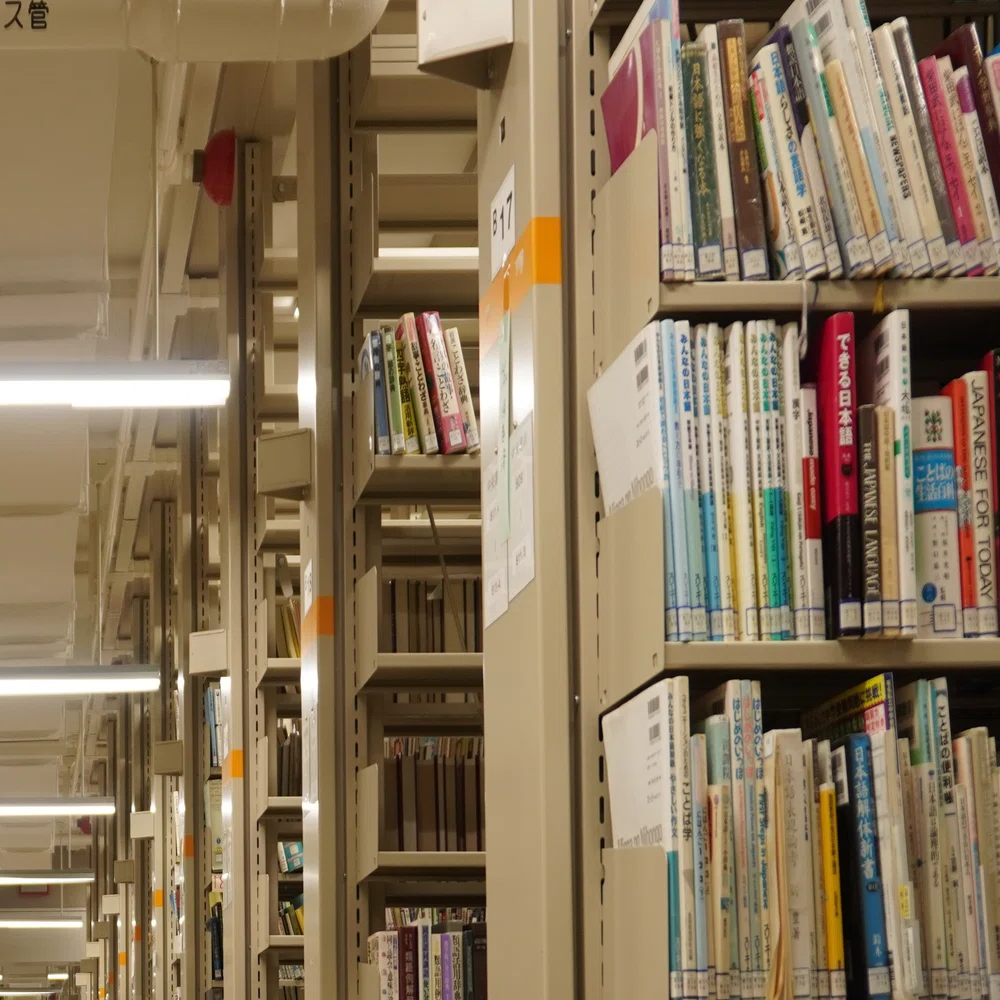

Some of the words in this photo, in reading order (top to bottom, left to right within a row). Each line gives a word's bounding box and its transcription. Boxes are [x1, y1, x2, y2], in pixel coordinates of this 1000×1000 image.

[889, 133, 912, 200] NEWSPAPERS
[499, 191, 513, 240] 17
[837, 332, 853, 446] できる日本語
[863, 440, 872, 460] THE
[971, 379, 988, 483] JAPANESE
[863, 461, 878, 523] JAPANESE
[974, 488, 989, 527] FOR
[865, 529, 881, 597] LANGUAGE
[976, 534, 993, 601] TODAY
[854, 746, 874, 879] 日本語解体新書
